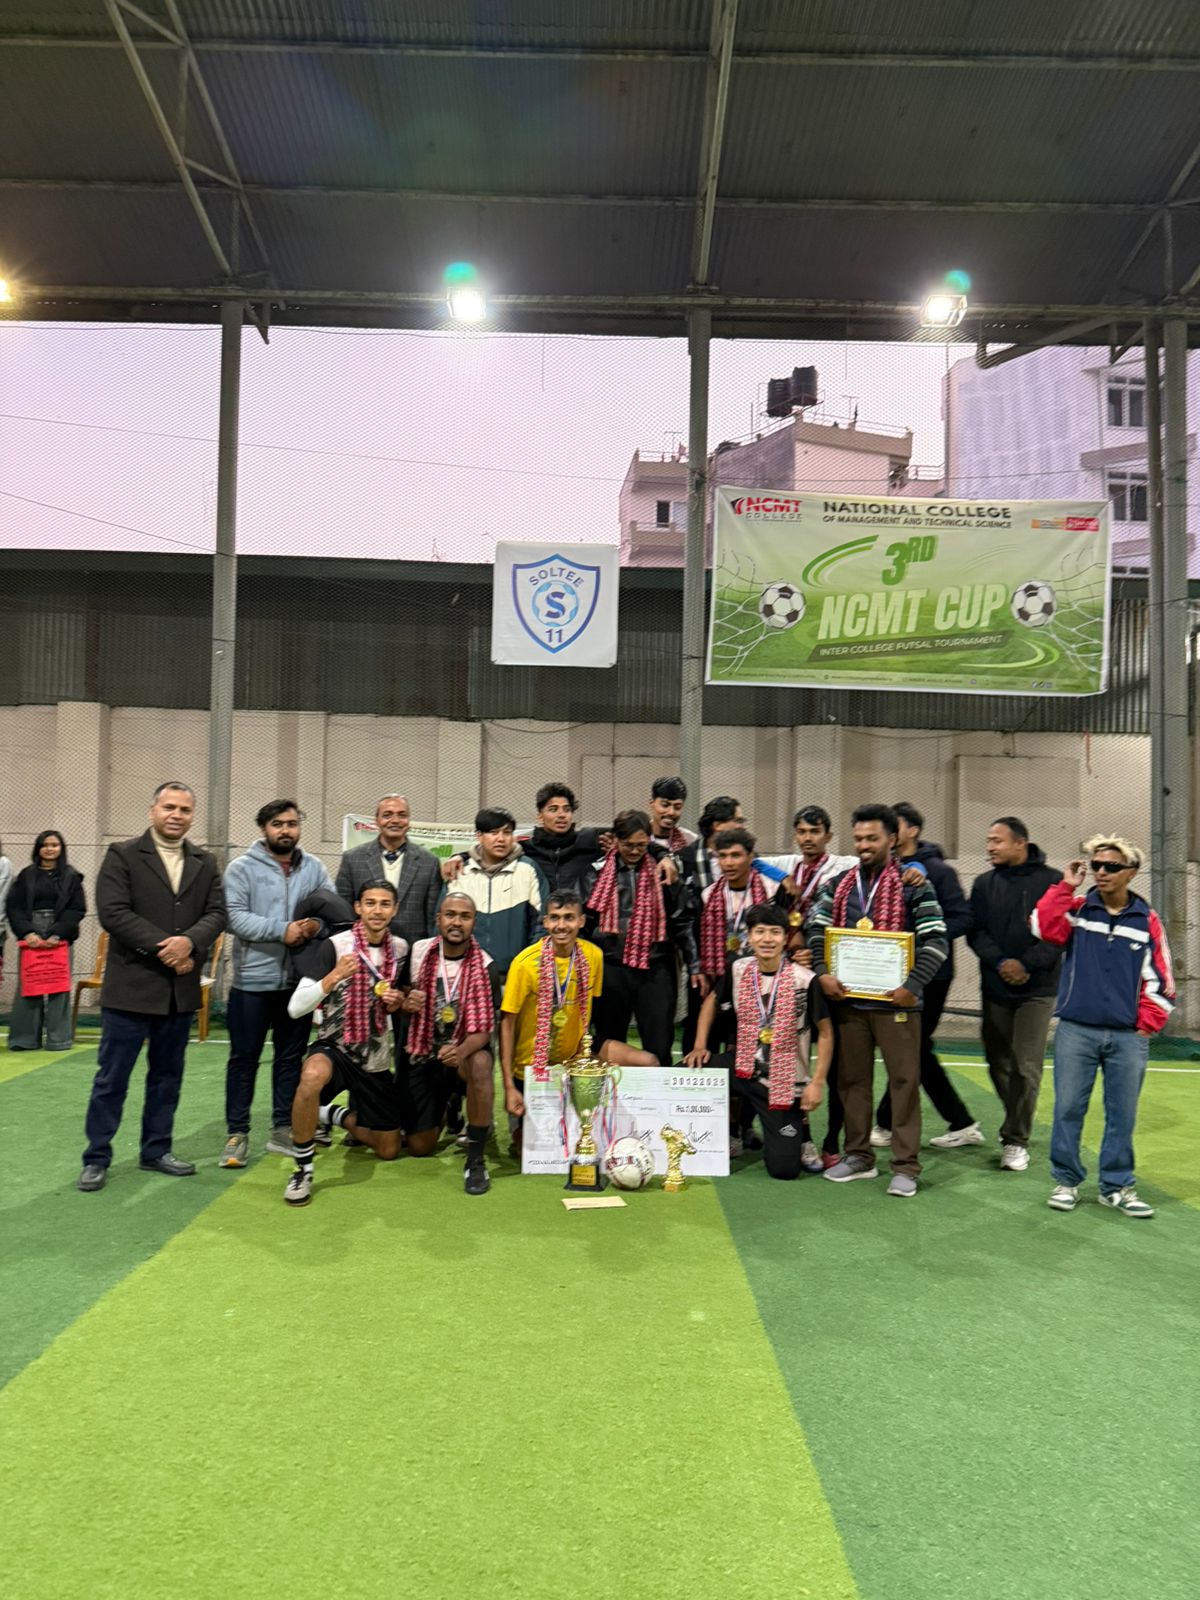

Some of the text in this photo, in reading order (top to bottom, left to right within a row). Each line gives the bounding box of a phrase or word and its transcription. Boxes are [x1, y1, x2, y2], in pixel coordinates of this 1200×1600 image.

[746, 497, 802, 513] NCMT
[823, 501, 1012, 519] NATIONAL COLLEGE
[746, 512, 803, 520] COLLEGE
[823, 515, 1012, 529] OF MANAGEMENT AND TECHNICAL SCIENCE
[881, 535, 938, 586] 3RD
[529, 567, 584, 588] SOLTEE
[545, 591, 566, 619] S
[817, 583, 1007, 641] NCMT CUP
[545, 628, 563, 643] 11
[819, 635, 1004, 656] INTER COLLEGE FUTSAL TOURNAMENT
